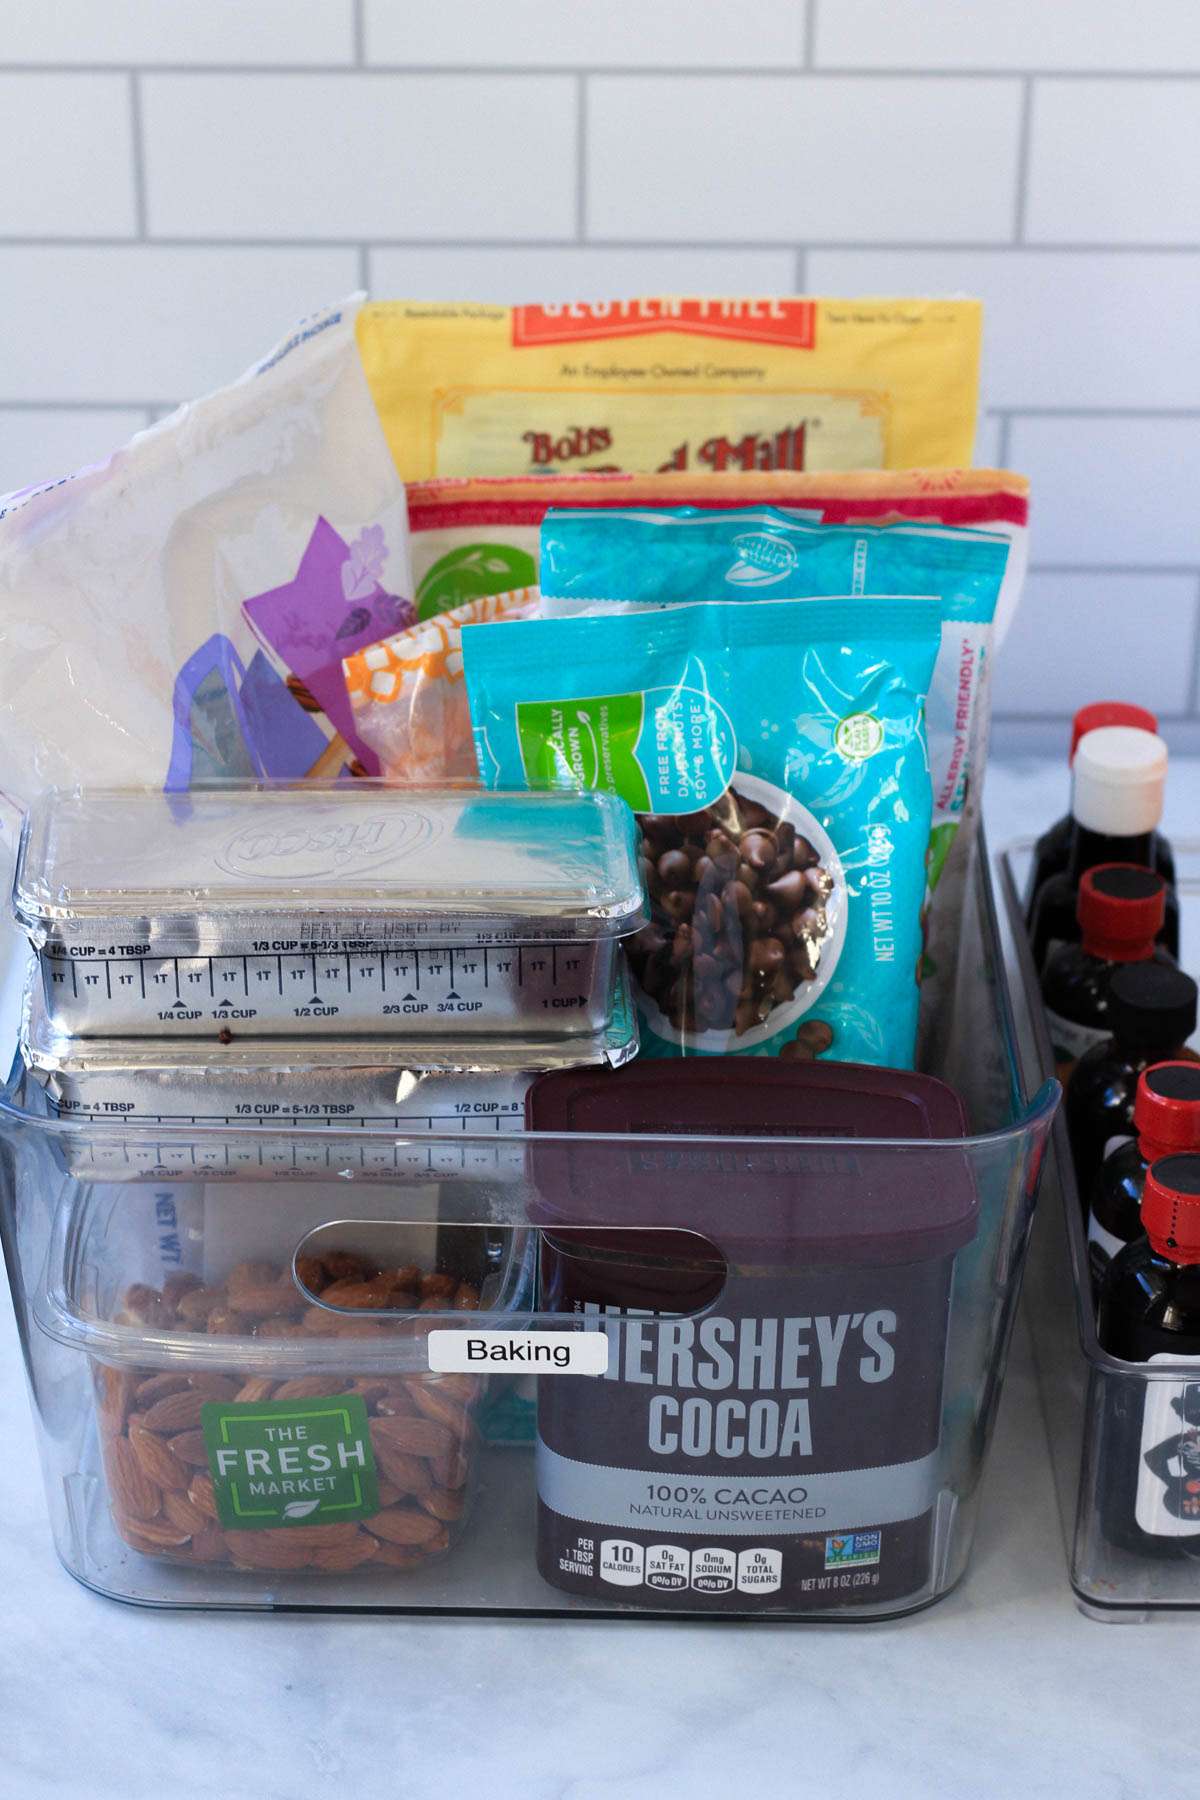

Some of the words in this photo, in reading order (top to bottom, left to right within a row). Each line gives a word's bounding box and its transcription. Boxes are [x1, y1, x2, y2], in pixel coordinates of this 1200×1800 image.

[658, 755, 671, 795] FREE
[937, 735, 965, 811] ALLERGY
[695, 770, 707, 800] SOY
[870, 870, 892, 888] OZ
[871, 891, 892, 907] 10
[872, 911, 893, 933] WT
[70, 947, 95, 957] CUP
[109, 946, 115, 956] 4
[118, 944, 151, 956] TBSP
[253, 941, 269, 951] 1/3
[272, 941, 298, 950] CUP
[874, 937, 895, 961] NET
[52, 973, 65, 983] 1T
[85, 976, 99, 985] 1T
[119, 975, 133, 985] 1T
[153, 974, 167, 983] 1T
[188, 973, 202, 982] 1T
[223, 972, 236, 981] 1T
[257, 971, 271, 980] 1T
[291, 970, 305, 979] 1T
[326, 968, 339, 978] 1T
[360, 968, 374, 977] 1T
[395, 967, 408, 976] 1T
[428, 965, 443, 974] 1T
[463, 964, 477, 973] 1T
[497, 963, 511, 972] 1T
[531, 961, 545, 971] 1T
[566, 960, 580, 970] 1T
[383, 1005, 400, 1014] 2/3
[403, 1004, 428, 1013] CUP
[437, 1003, 454, 1012] 3/4
[457, 1002, 482, 1011] CUP
[552, 998, 578, 1008] CUP
[158, 1011, 173, 1020] 1/4
[176, 1010, 202, 1020] CUP
[212, 1010, 228, 1019] 1/3
[231, 1010, 257, 1019] CUP
[294, 1008, 312, 1017] 1/2
[314, 1007, 338, 1016] CUP
[93, 1102, 100, 1111] 4
[103, 1102, 135, 1112] TBSP
[235, 1104, 251, 1113] 1/3
[255, 1104, 280, 1114] CUP
[293, 1104, 319, 1114] 5-1/3
[322, 1104, 355, 1114] TBSP
[455, 1103, 471, 1113] 1/2
[474, 1103, 499, 1112] CUP
[511, 1103, 518, 1111] 8
[155, 1192, 177, 1228] NET
[159, 1233, 181, 1264] WT
[584, 1302, 897, 1391] HERSHEY'S
[467, 1339, 570, 1368] Baking
[648, 1395, 813, 1459] COCOA
[264, 1426, 308, 1442] THE
[216, 1440, 365, 1476] FRESH
[250, 1476, 336, 1496] MARKET
[647, 1485, 706, 1504] 100%
[714, 1487, 808, 1505] CACAO
[630, 1503, 701, 1520] NATURAL
[706, 1507, 826, 1521] UNSWEETENED
[578, 1538, 594, 1550] PER
[855, 1533, 878, 1543] NON
[572, 1549, 594, 1562] TBSP
[611, 1545, 634, 1563] 10
[661, 1550, 674, 1562] 0g
[704, 1553, 724, 1565] 0mg
[754, 1553, 766, 1565] 0g
[559, 1559, 594, 1577] SERVING
[602, 1561, 641, 1574] CALORIES
[650, 1560, 666, 1571] SAT
[669, 1561, 685, 1572] FAT
[696, 1564, 732, 1574] SODIUM
[746, 1565, 774, 1574] TOTAL
[671, 1577, 682, 1586] DV
[717, 1579, 728, 1589] DV
[741, 1574, 778, 1584] SUGARS
[801, 1578, 816, 1591] NET
[817, 1576, 832, 1589] WT
[833, 1576, 839, 1588] 8
[840, 1574, 850, 1587] OZ
